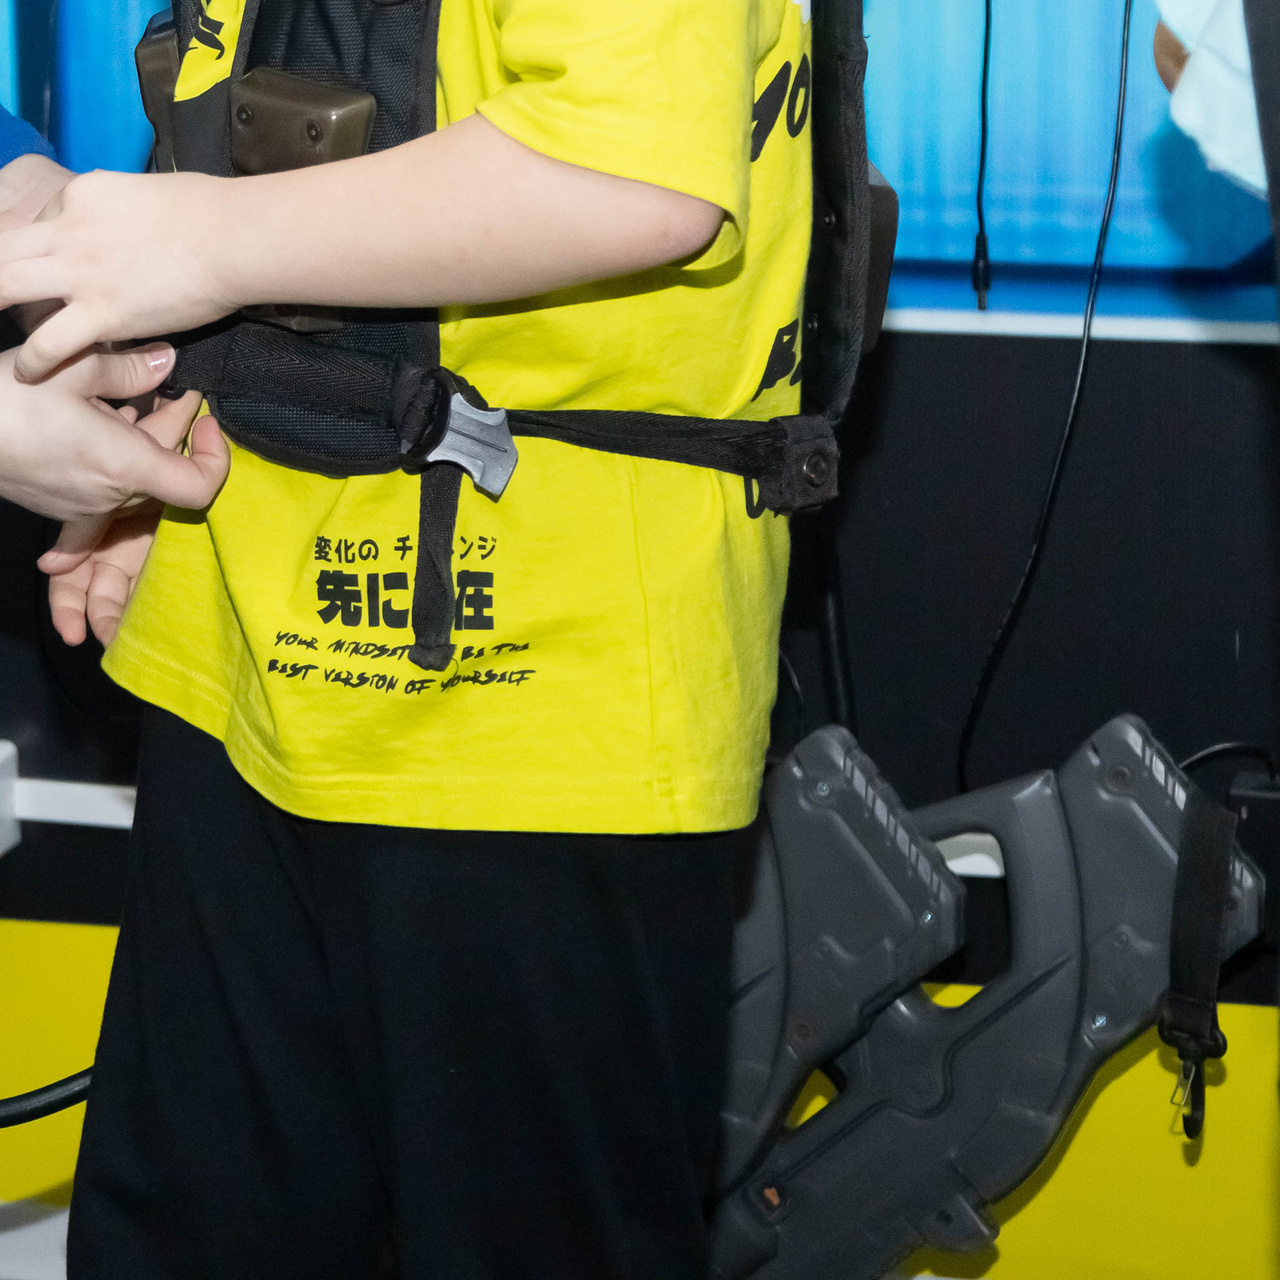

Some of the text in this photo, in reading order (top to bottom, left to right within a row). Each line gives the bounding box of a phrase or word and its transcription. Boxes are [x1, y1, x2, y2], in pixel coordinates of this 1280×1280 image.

[314, 536, 380, 564] 変化の
[315, 569, 494, 631] 先に在
[268, 659, 319, 681] BEST
[324, 668, 399, 694] VERSION
[404, 679, 436, 695] OF
